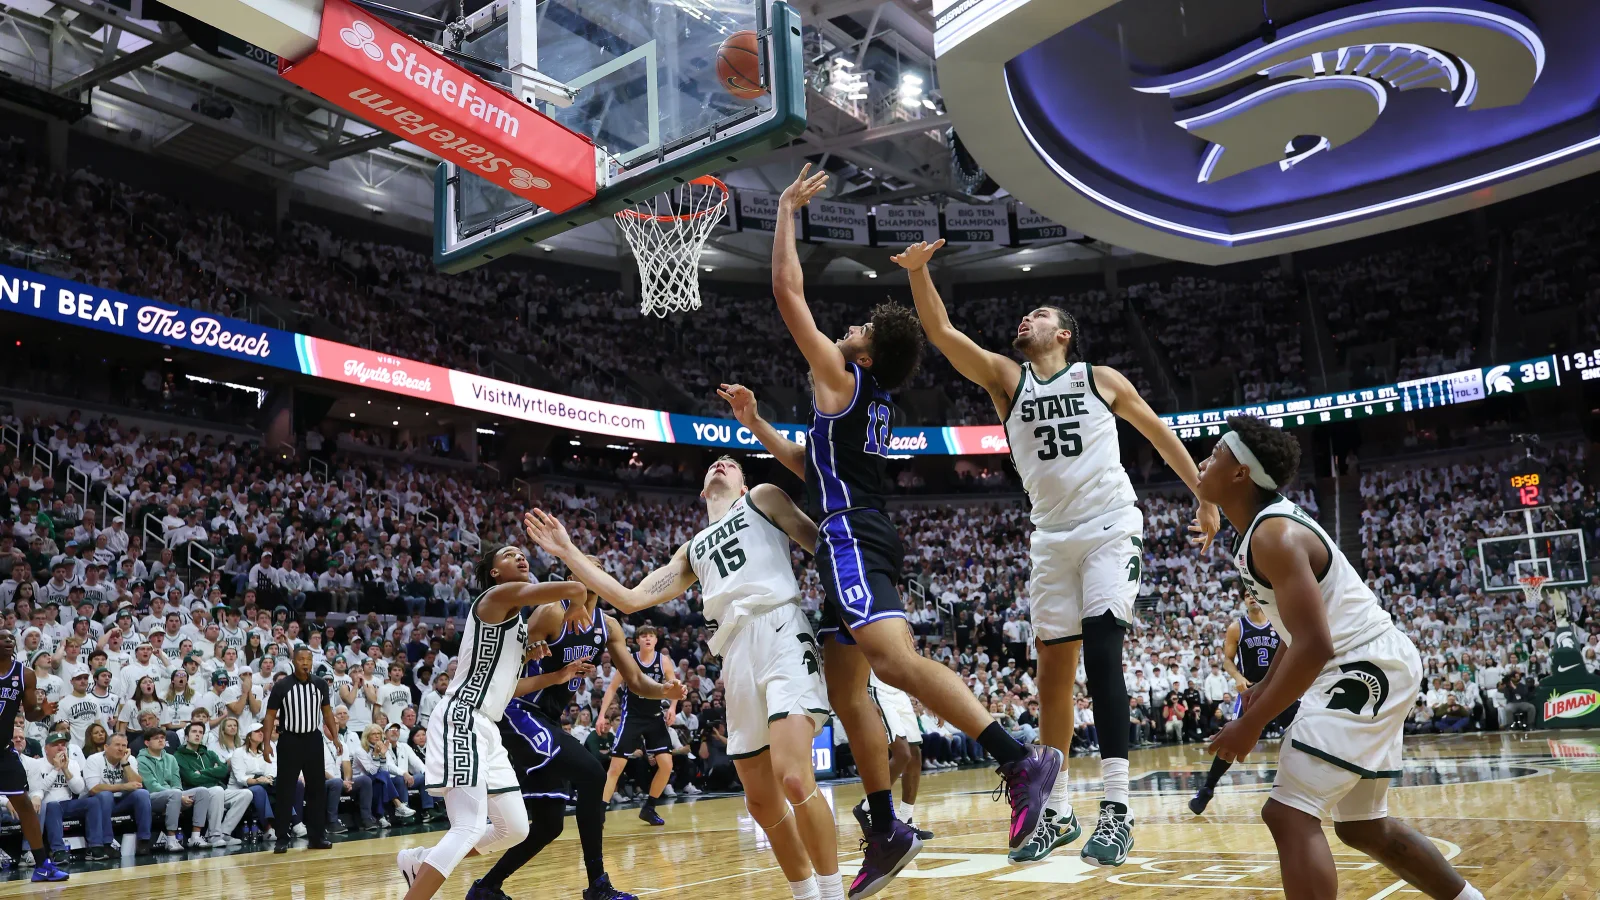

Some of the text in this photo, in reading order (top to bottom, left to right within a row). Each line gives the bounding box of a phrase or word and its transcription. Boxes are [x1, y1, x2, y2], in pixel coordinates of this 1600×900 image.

[245, 44, 278, 67] 2012
[753, 197, 769, 207] BIG
[820, 204, 856, 216] BIG TEN
[888, 209, 925, 218] BIG TEN
[958, 209, 995, 217] BIG TEN
[810, 213, 867, 227] CHAMPIONS
[878, 218, 938, 227] CHAMPIONS
[948, 218, 1007, 227] CHAMPIONS
[828, 228, 852, 238] 1998
[895, 231, 922, 241] 1990
[966, 231, 991, 240] 1979
[1038, 227, 1064, 238] 1978
[58, 289, 128, 327] BEAT
[137, 305, 187, 340] The
[191, 316, 270, 358] Beach
[377, 355, 401, 367] VISIT
[343, 359, 432, 393] Myrtle Beach
[1519, 360, 1551, 383] 39
[1453, 376, 1469, 385] FLS
[1313, 396, 1332, 408] AST
[1336, 393, 1357, 405] BLK
[1360, 390, 1374, 401] TO
[1378, 386, 1398, 398] STL
[1455, 387, 1479, 398] TOL 3
[471, 382, 646, 431] VisitMyrtleBeach.com
[1021, 393, 1090, 422] STATE
[1364, 405, 1373, 415] 4
[692, 422, 731, 443] YOU
[863, 401, 891, 458] 12
[1033, 421, 1083, 461] 35
[1510, 473, 1540, 488] 13:58
[1519, 486, 1539, 506] 12
[695, 511, 750, 560] STATE
[709, 537, 746, 579] 15
[1244, 635, 1278, 649] DUKE
[1257, 647, 1269, 667] 2
[1543, 692, 1596, 721] LIBMAN
